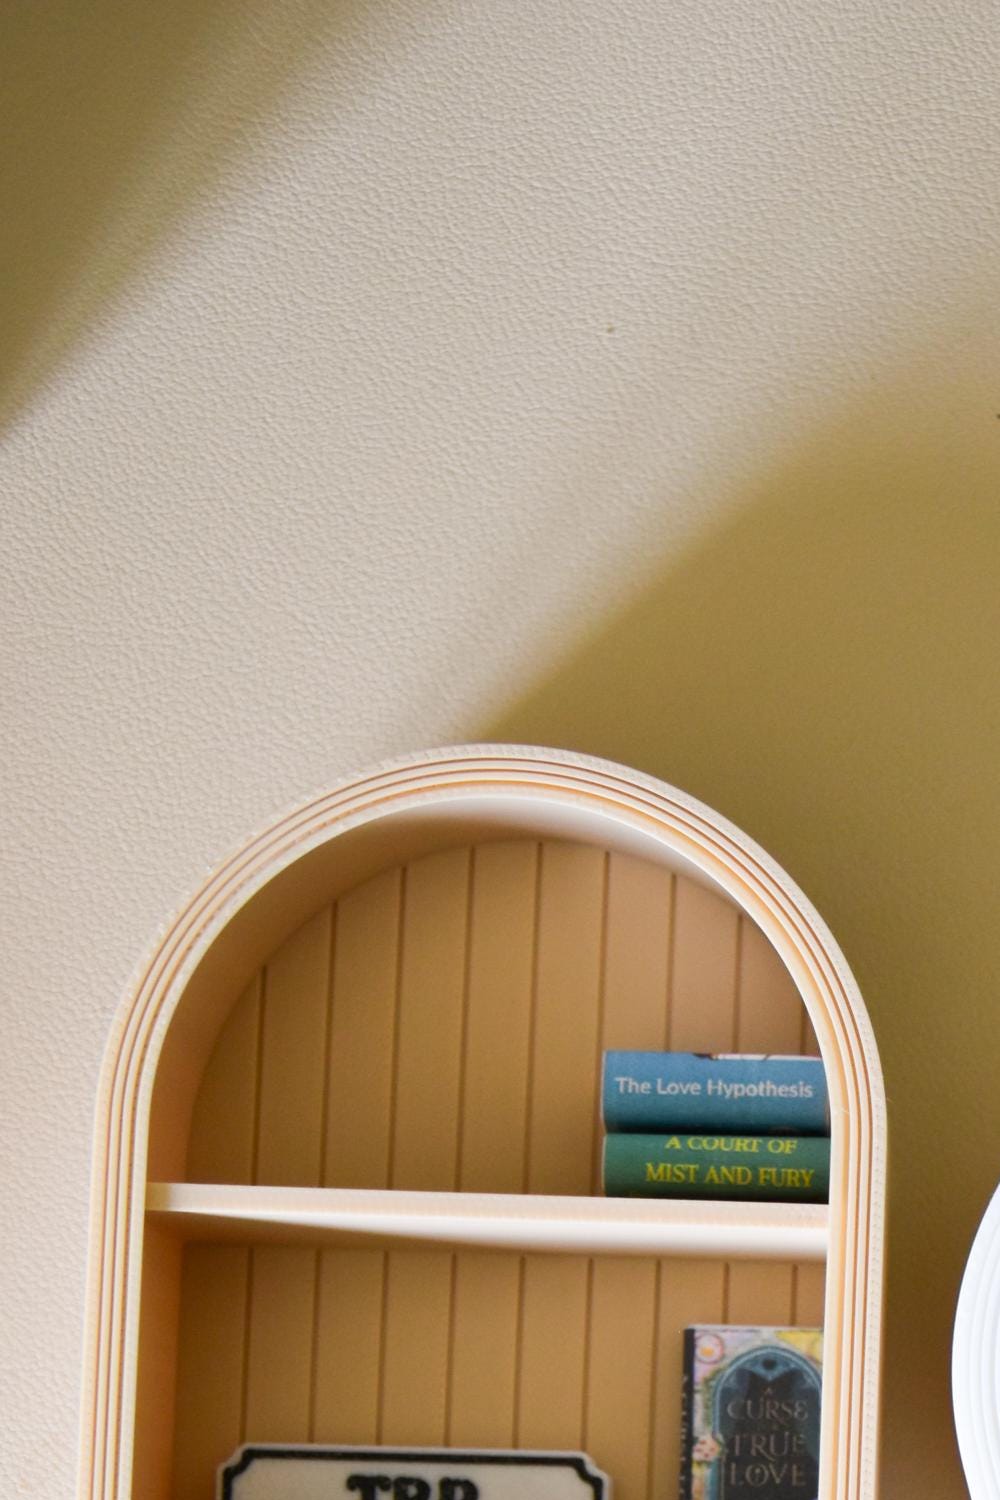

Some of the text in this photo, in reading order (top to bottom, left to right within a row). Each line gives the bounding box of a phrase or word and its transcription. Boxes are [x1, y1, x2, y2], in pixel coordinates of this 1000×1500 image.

[615, 1077, 813, 1099] The Love Hypothesis
[665, 1135, 797, 1154] A COURT OF
[646, 1163, 815, 1188] MIST AND FURY
[727, 1399, 809, 1425] CURSE
[732, 1431, 806, 1462] TRUE
[730, 1463, 806, 1487] LOVE
